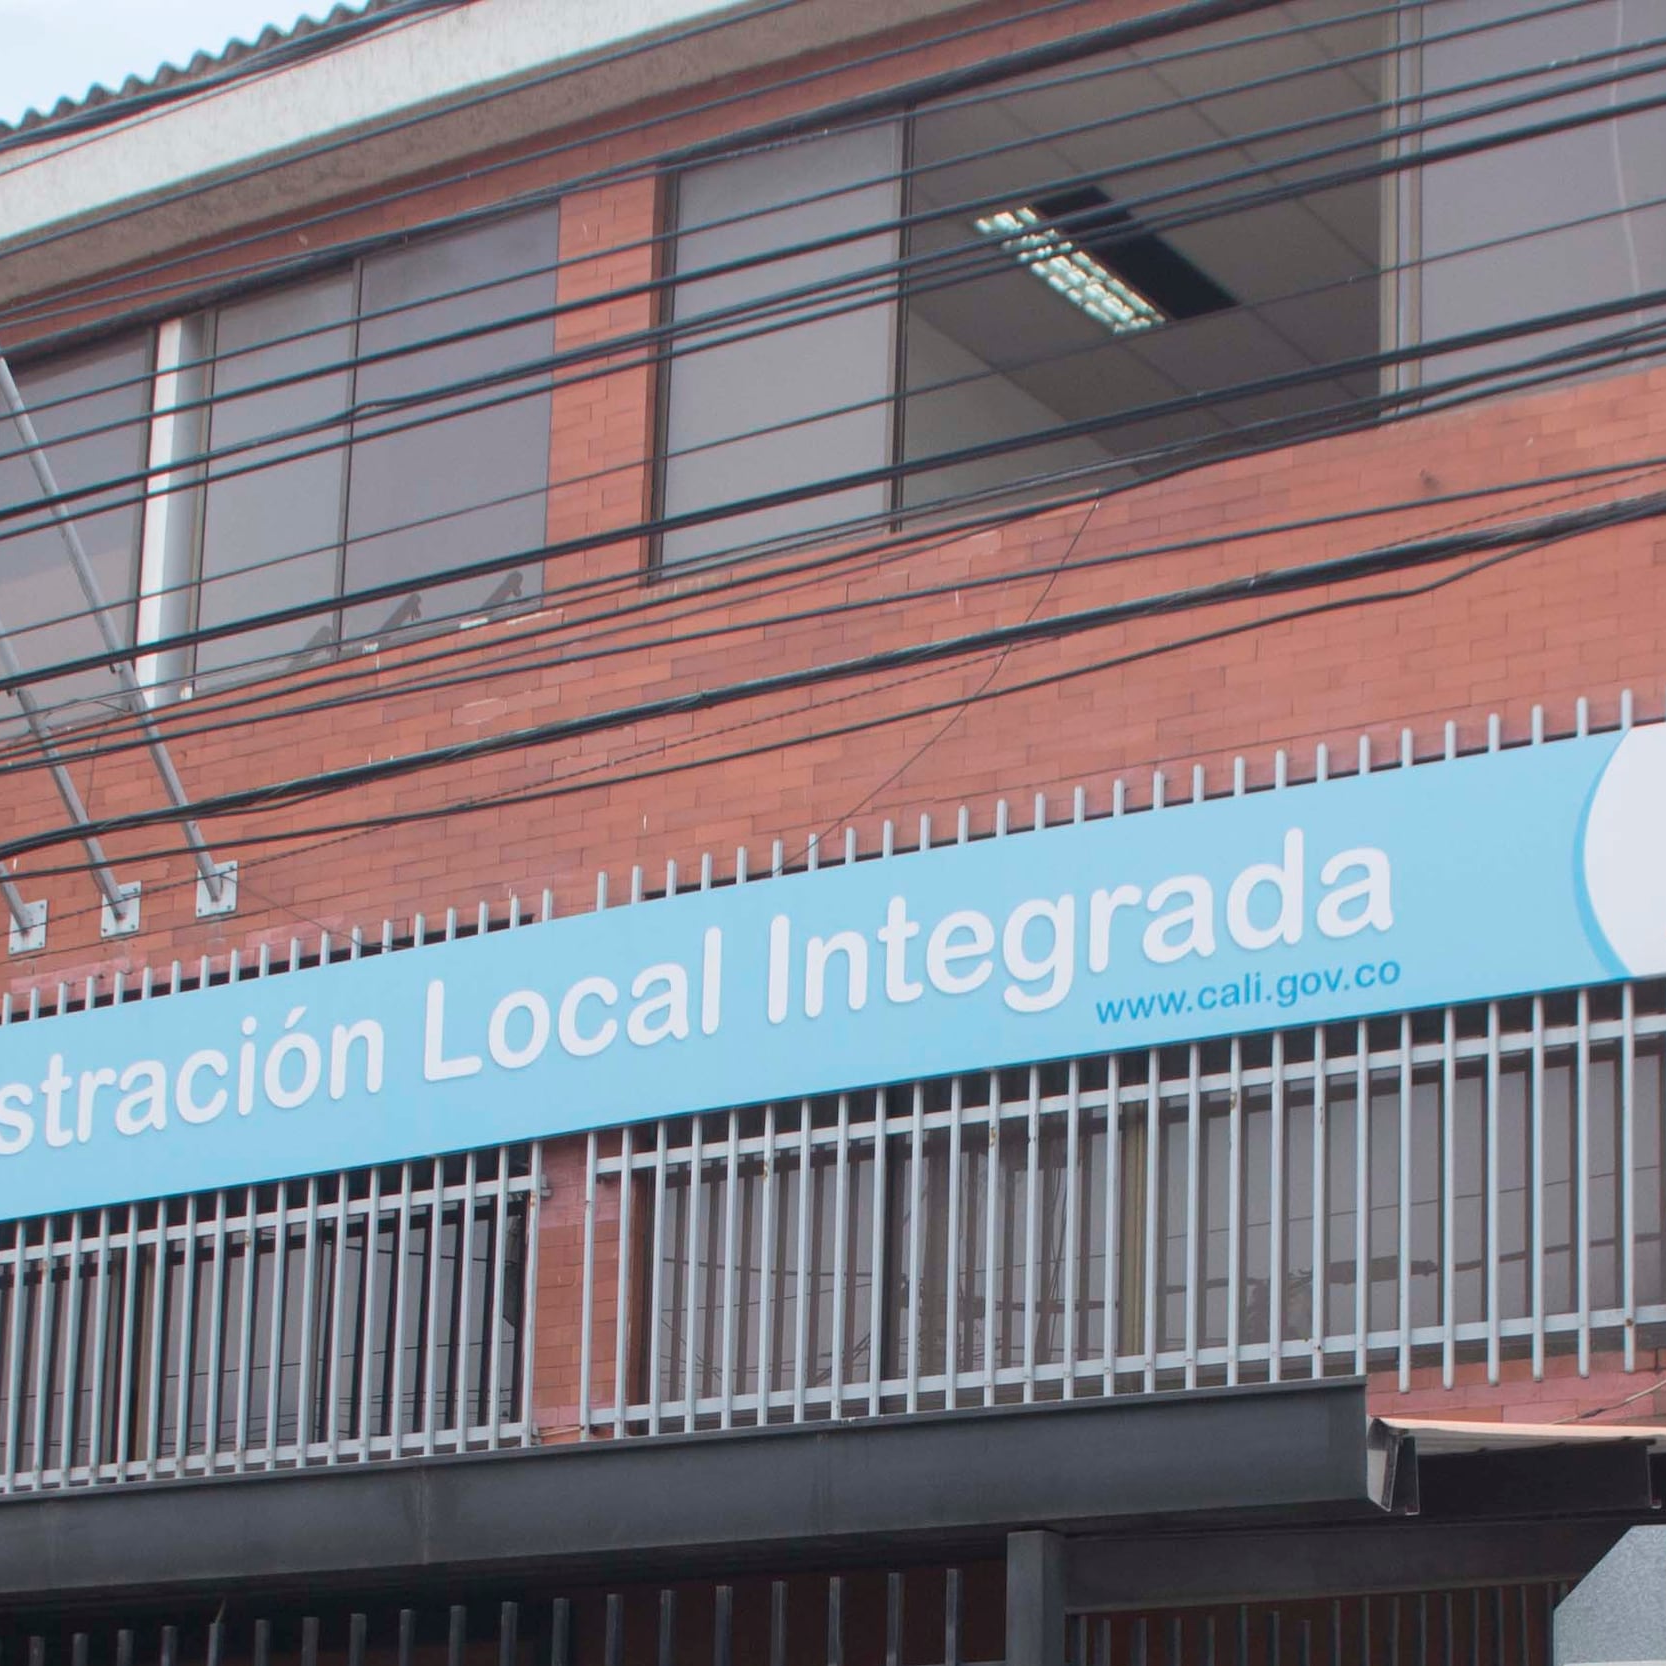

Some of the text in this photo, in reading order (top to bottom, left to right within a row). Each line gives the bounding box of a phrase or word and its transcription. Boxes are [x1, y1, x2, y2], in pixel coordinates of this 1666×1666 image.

[422, 925, 723, 1082] Local
[767, 825, 1395, 1025] Integrada
[1095, 960, 1402, 1025] www.cali.gov.co
